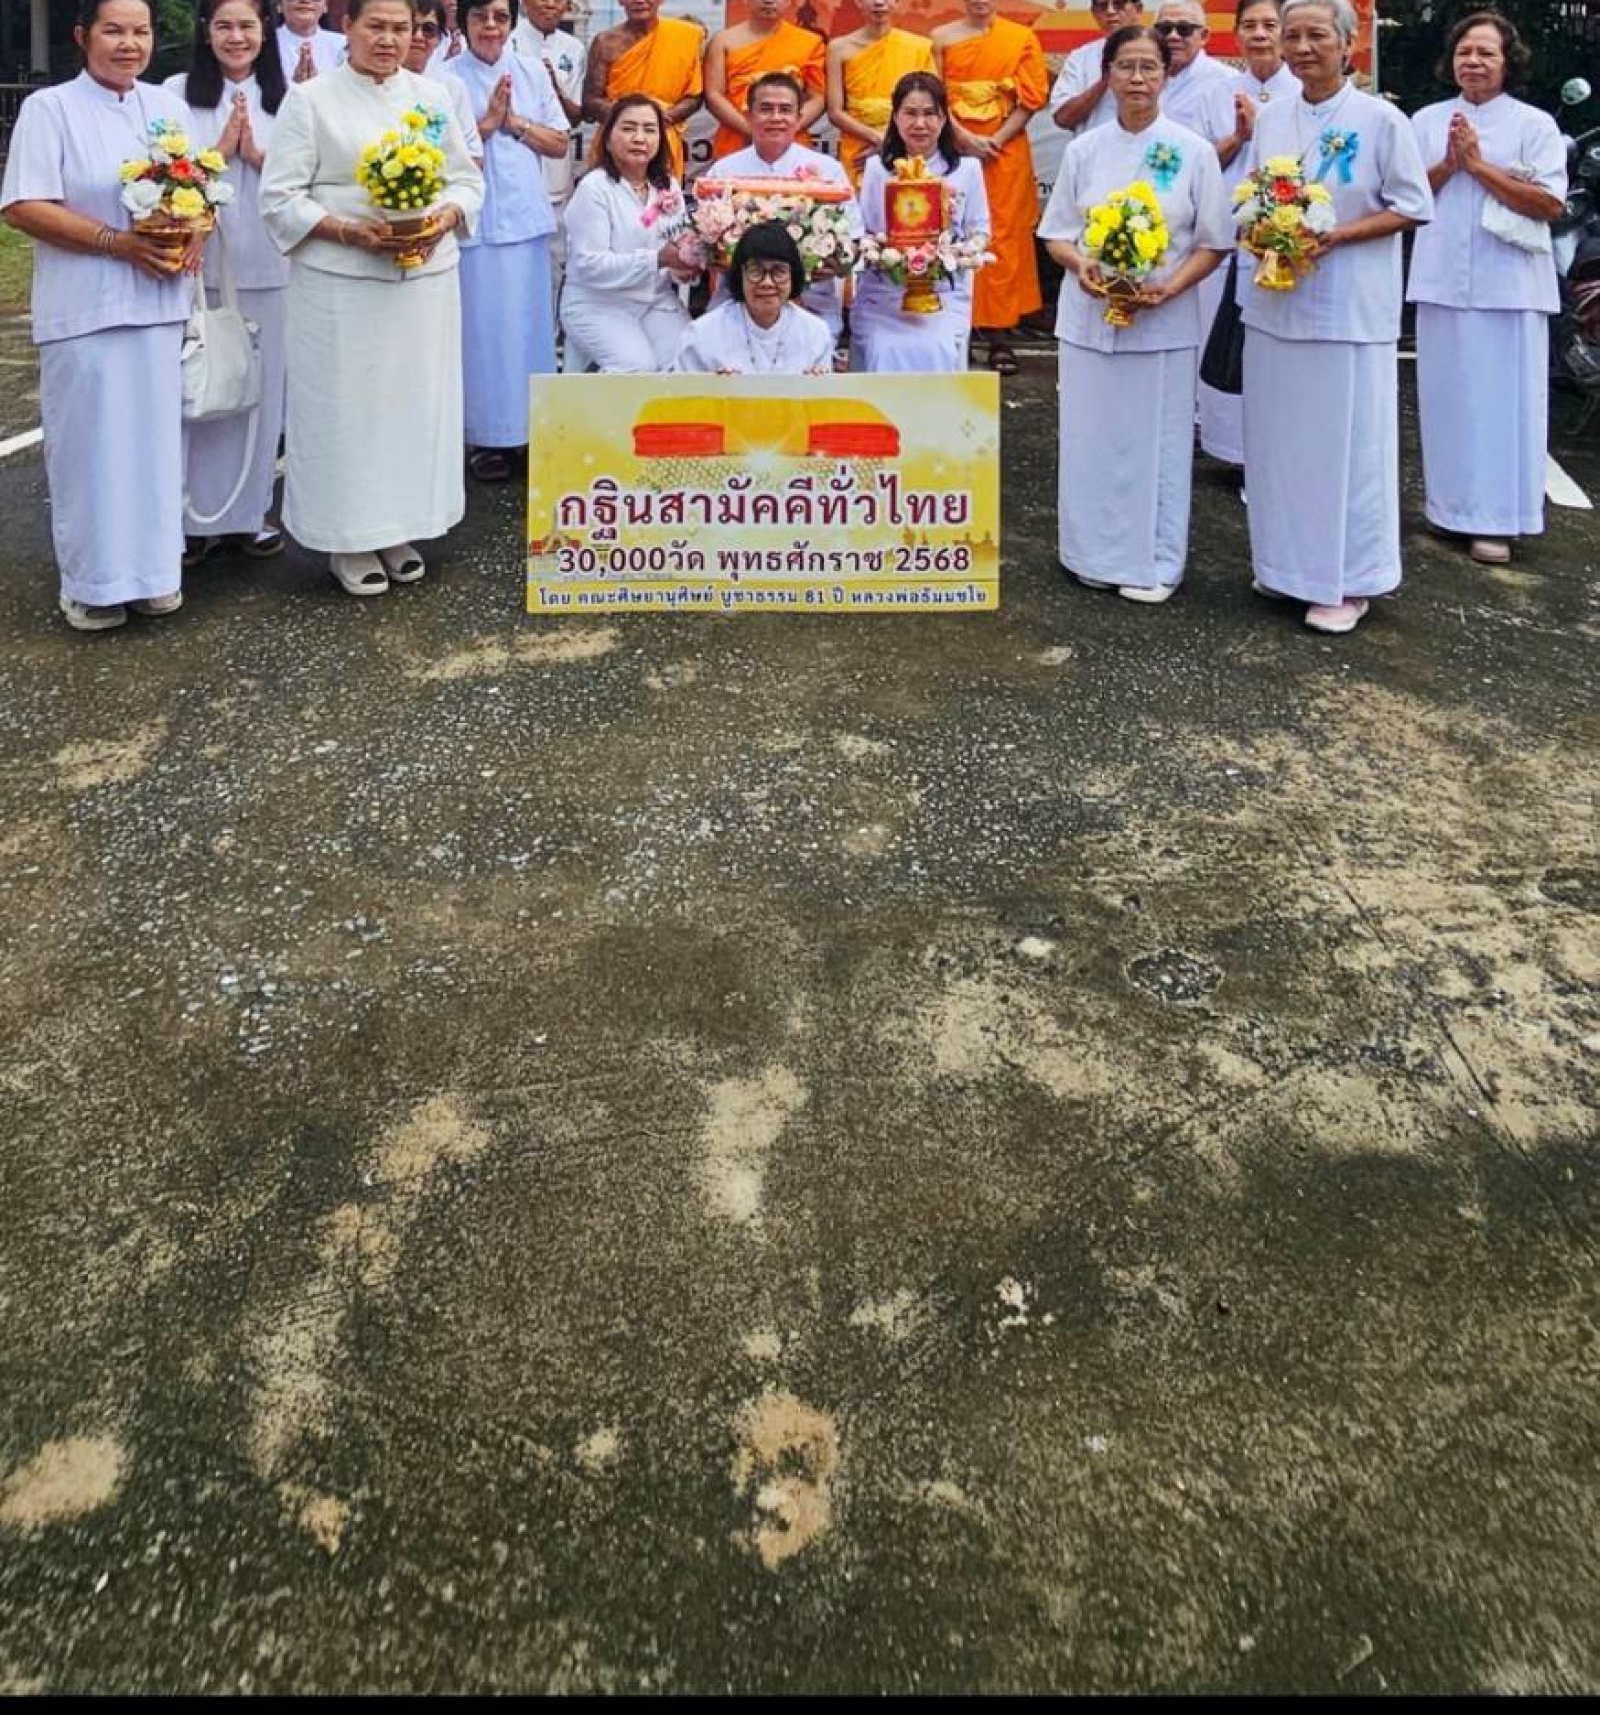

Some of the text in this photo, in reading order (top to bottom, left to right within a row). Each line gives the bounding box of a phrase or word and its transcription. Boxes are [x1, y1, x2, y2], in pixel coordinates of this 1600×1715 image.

[559, 465, 968, 541] กฐินสามัคคีทั่วไทย
[717, 540, 884, 582] พุทธศักราช
[895, 547, 970, 573] 2568
[539, 586, 571, 605] โดย
[720, 590, 798, 608] บูชาธรรม
[804, 589, 825, 605] 81
[832, 586, 844, 605] ปี
